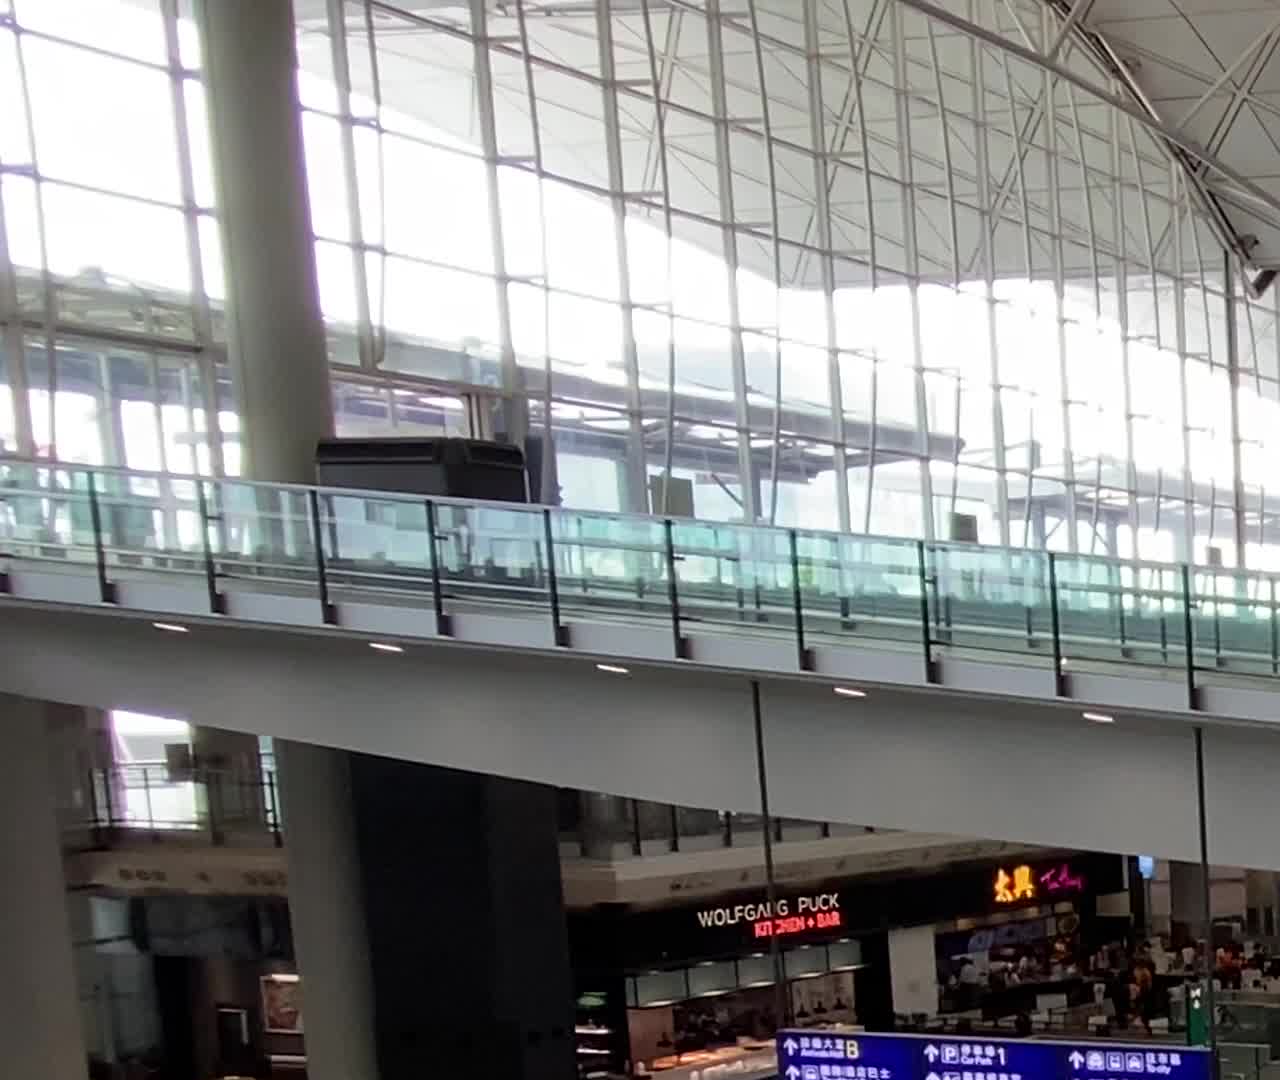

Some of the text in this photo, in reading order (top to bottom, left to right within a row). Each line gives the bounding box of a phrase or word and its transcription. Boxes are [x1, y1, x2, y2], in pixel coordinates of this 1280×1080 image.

[797, 893, 840, 913] PUCK
[817, 911, 841, 928] BAR
[846, 1040, 859, 1059] B
[997, 1047, 1006, 1066] 1
